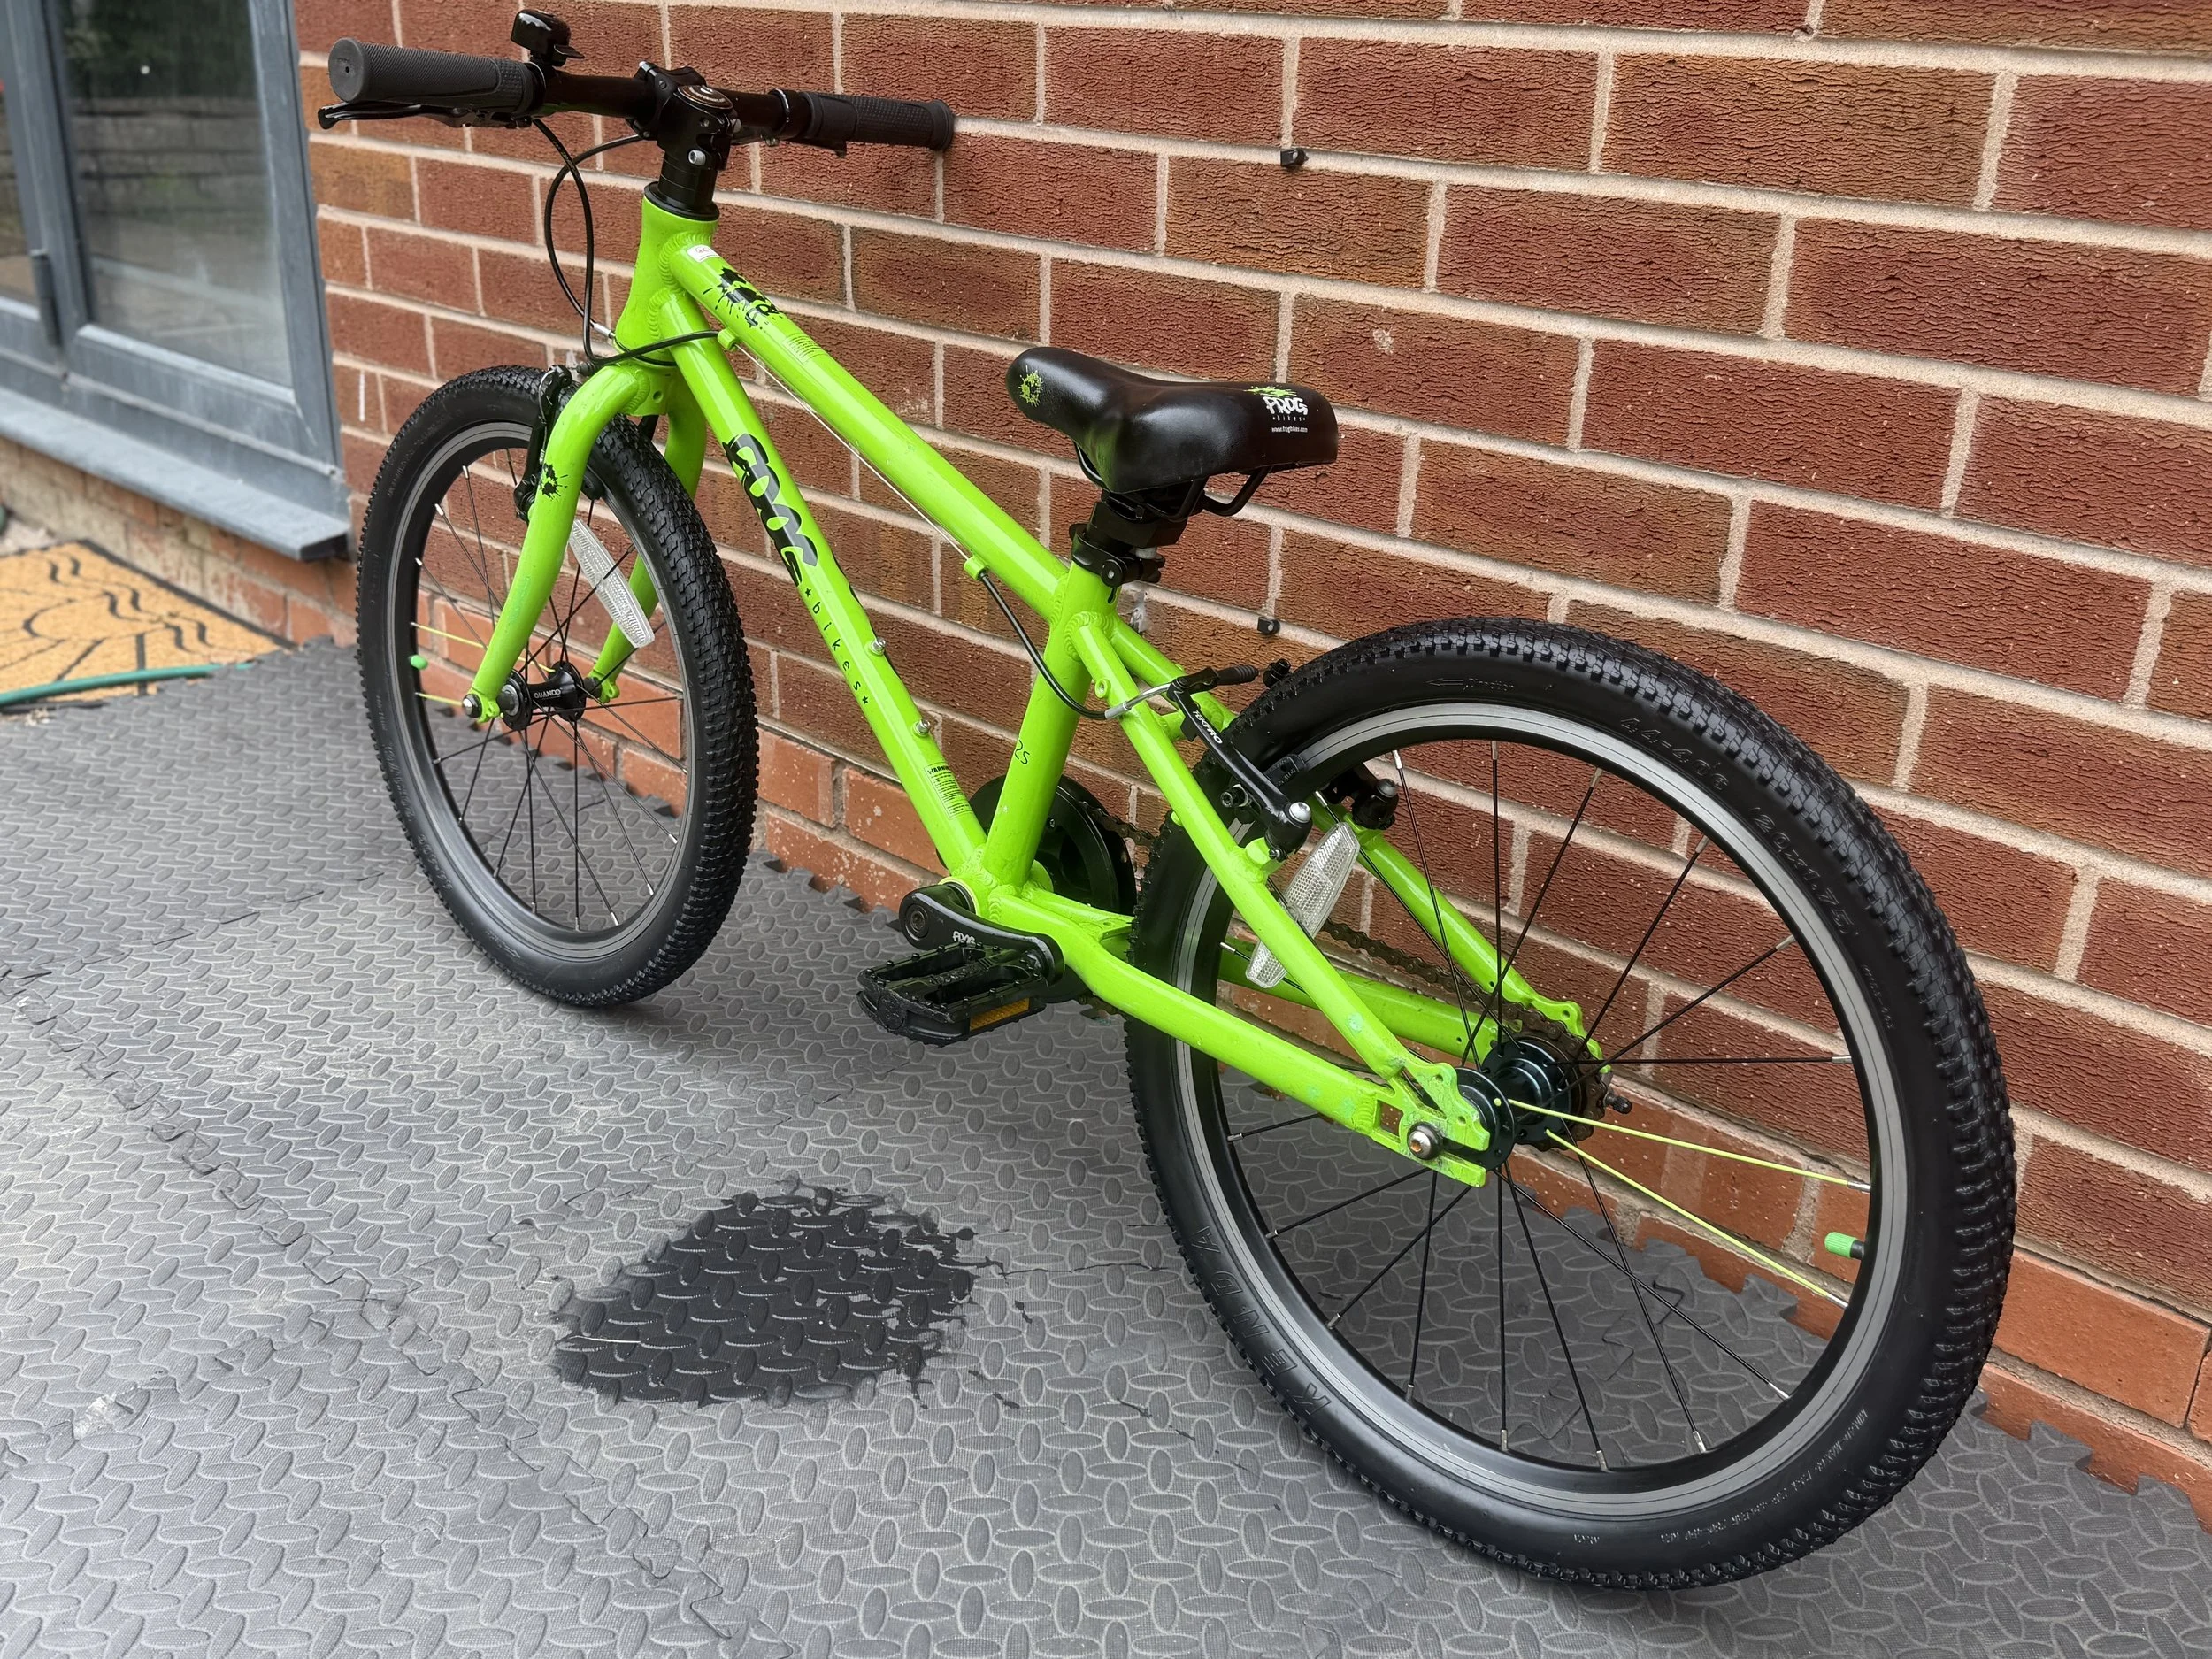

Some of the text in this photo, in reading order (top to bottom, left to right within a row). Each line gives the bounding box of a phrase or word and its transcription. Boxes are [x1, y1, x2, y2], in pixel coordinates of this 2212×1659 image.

[1263, 396, 1309, 415] FROG
[812, 601, 861, 692] bikes
[534, 688, 561, 699] QUANDO
[1192, 710, 1223, 744] TEKTRO
[1192, 1225, 1332, 1416] KENDA
